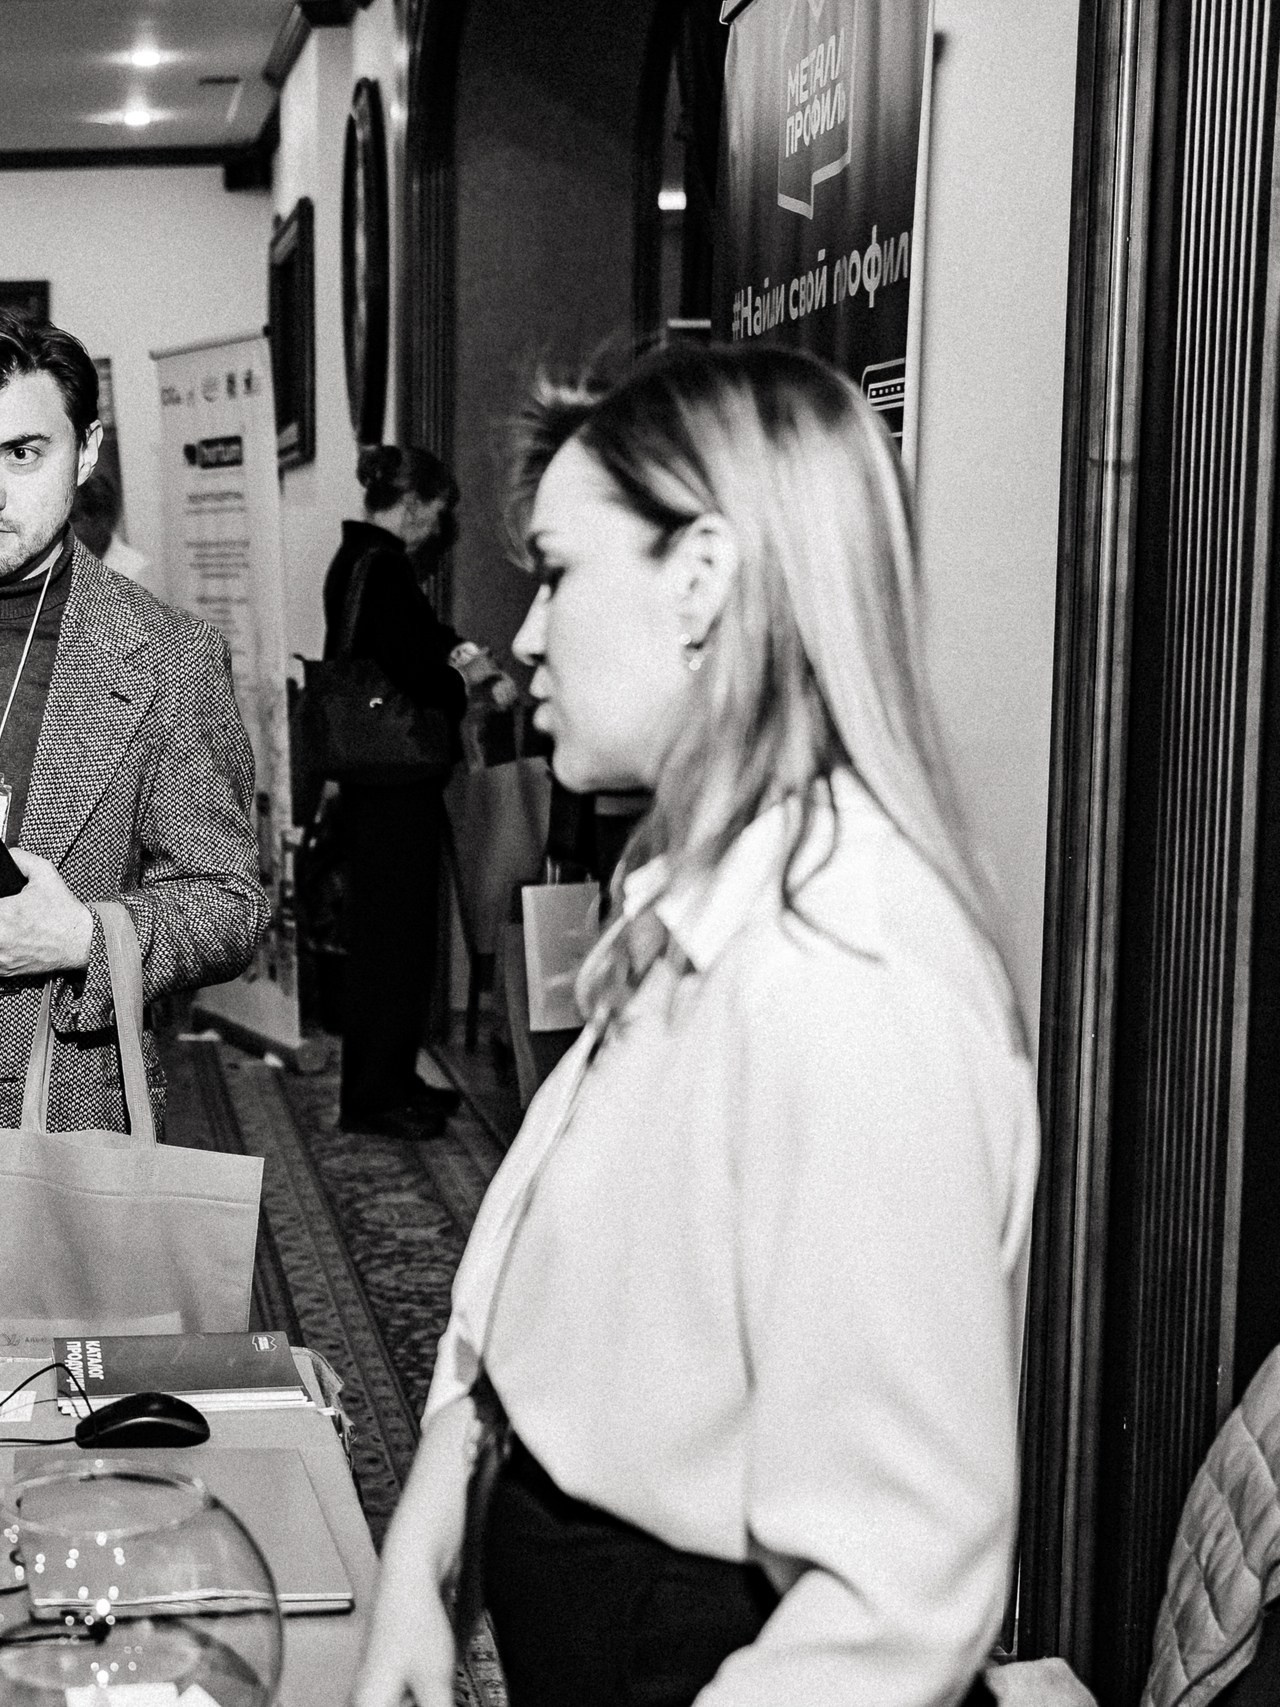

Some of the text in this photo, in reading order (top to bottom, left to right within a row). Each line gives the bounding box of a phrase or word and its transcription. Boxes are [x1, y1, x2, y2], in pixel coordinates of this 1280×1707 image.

[786, 27, 845, 113] МЕТАЛЛ
[785, 80, 847, 159] ПРОФИЛЬ
[789, 248, 828, 321] свой
[833, 224, 912, 309] профил
[85, 1340, 105, 1380] КАТАЛОГ
